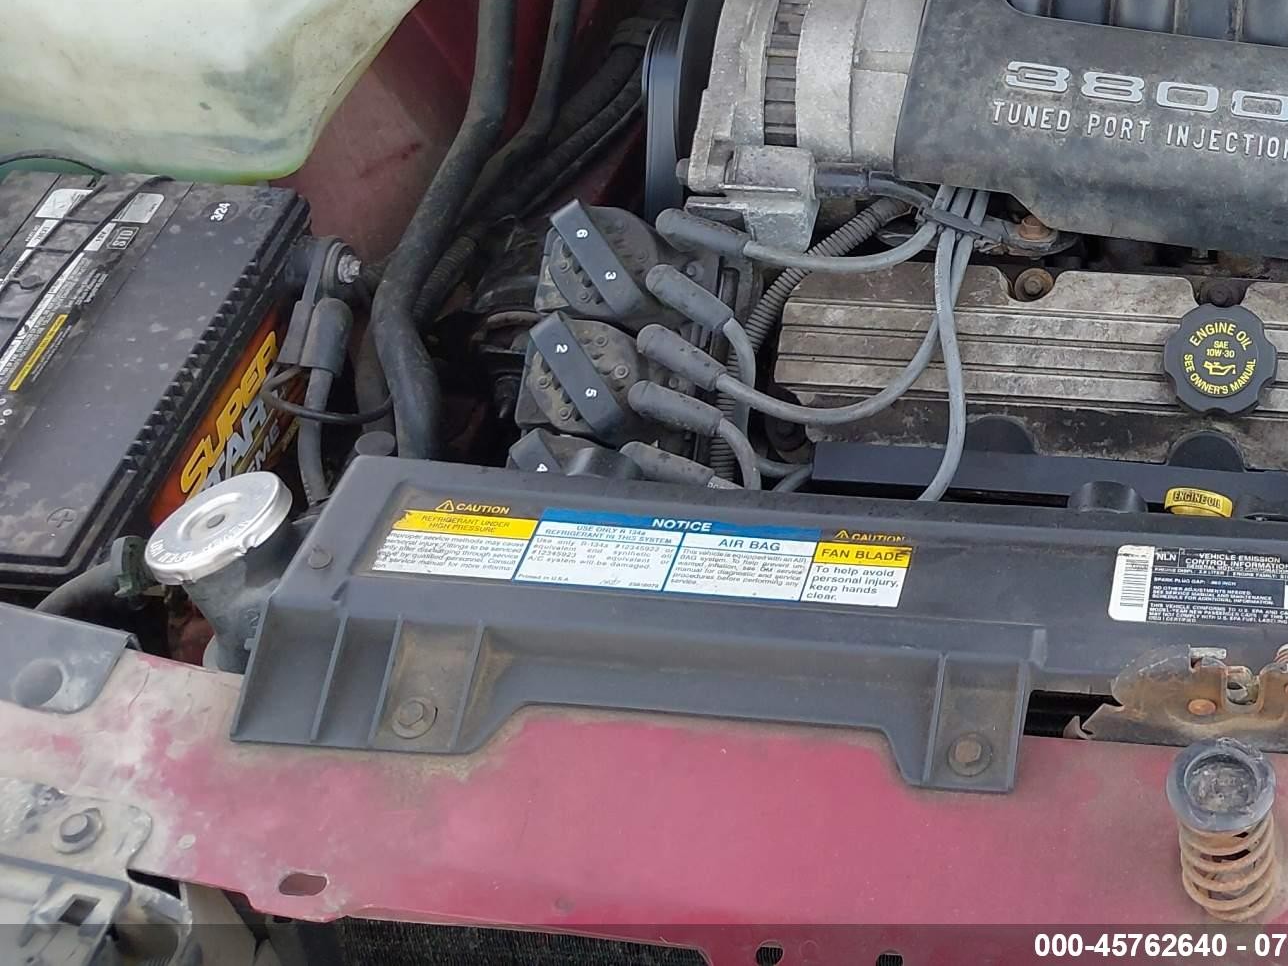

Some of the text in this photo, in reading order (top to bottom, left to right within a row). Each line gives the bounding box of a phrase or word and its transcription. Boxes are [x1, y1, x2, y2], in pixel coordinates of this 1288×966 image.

[992, 101, 1072, 133] TUNED
[1088, 113, 1151, 143] PORT
[113, 229, 135, 247] STD
[576, 229, 589, 239] 6
[605, 271, 617, 281] 3
[1189, 322, 1253, 351] ENGINE OIL
[556, 344, 568, 354] 2
[1214, 341, 1230, 349] SAE
[1206, 349, 1235, 358] 10W-30
[1184, 354, 1256, 394] SEE OWNER'S MANUAL
[585, 388, 597, 398] 5
[180, 331, 278, 493] SUPER
[1173, 490, 1221, 508] ENGINE OIL
[456, 503, 510, 514] CAUTION
[652, 518, 712, 532] NOTICE
[851, 533, 905, 543] CAUTION
[719, 539, 780, 551] AIR BAG
[821, 548, 905, 562] FAN BLADE
[1156, 553, 1177, 561] NLN
[1238, 555, 1280, 563] EMISSION
[816, 565, 894, 577] To help avoid
[812, 575, 899, 588] personal injury,
[809, 585, 878, 594] keep hands
[806, 592, 837, 601] clear.
